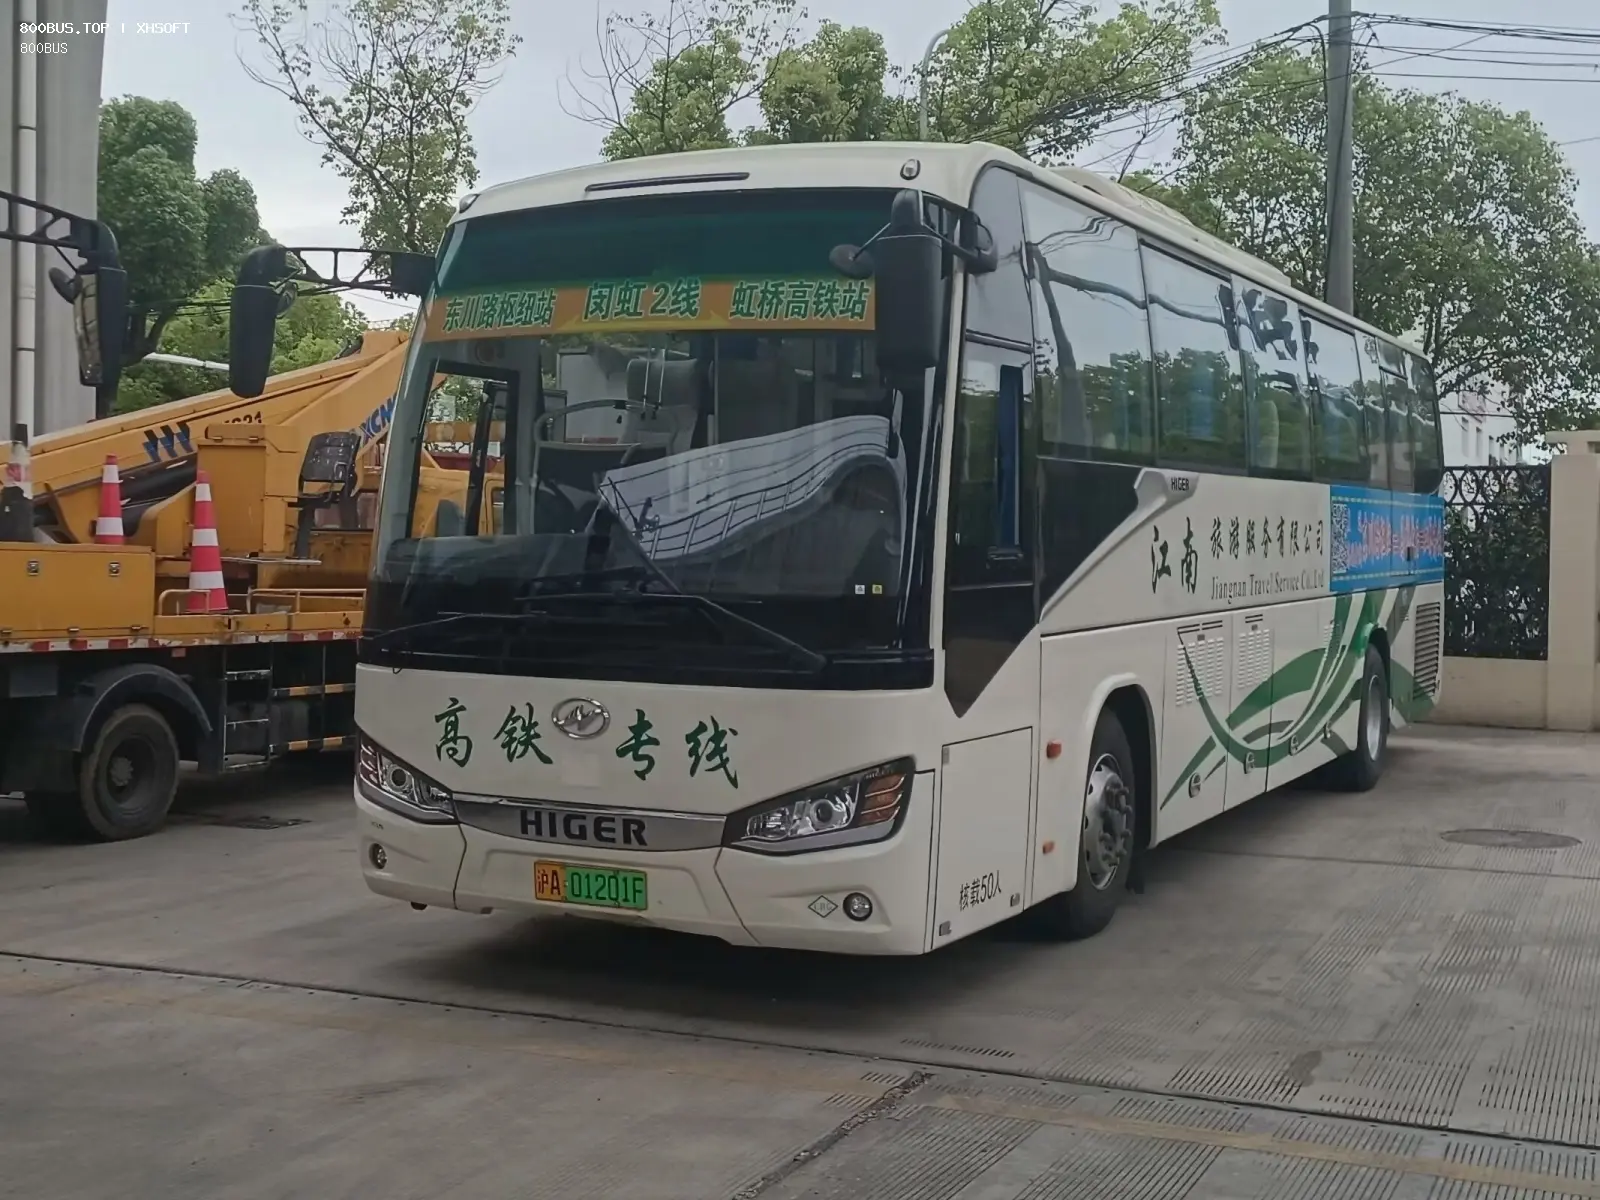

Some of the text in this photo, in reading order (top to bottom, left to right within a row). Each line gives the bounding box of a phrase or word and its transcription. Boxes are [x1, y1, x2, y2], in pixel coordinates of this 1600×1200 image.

[443, 279, 870, 332] 东川路枢纽站 闵虹2线 虹桥高铁站
[1170, 477, 1189, 491] HIGER
[1151, 516, 1198, 594] 江南
[1211, 576, 1246, 604] Jiangnan
[1249, 572, 1273, 596] Travel
[1274, 571, 1299, 593] Service
[434, 697, 738, 789] 高铁 专线
[519, 809, 648, 847] HIGER
[960, 870, 1002, 912] 核载50人
